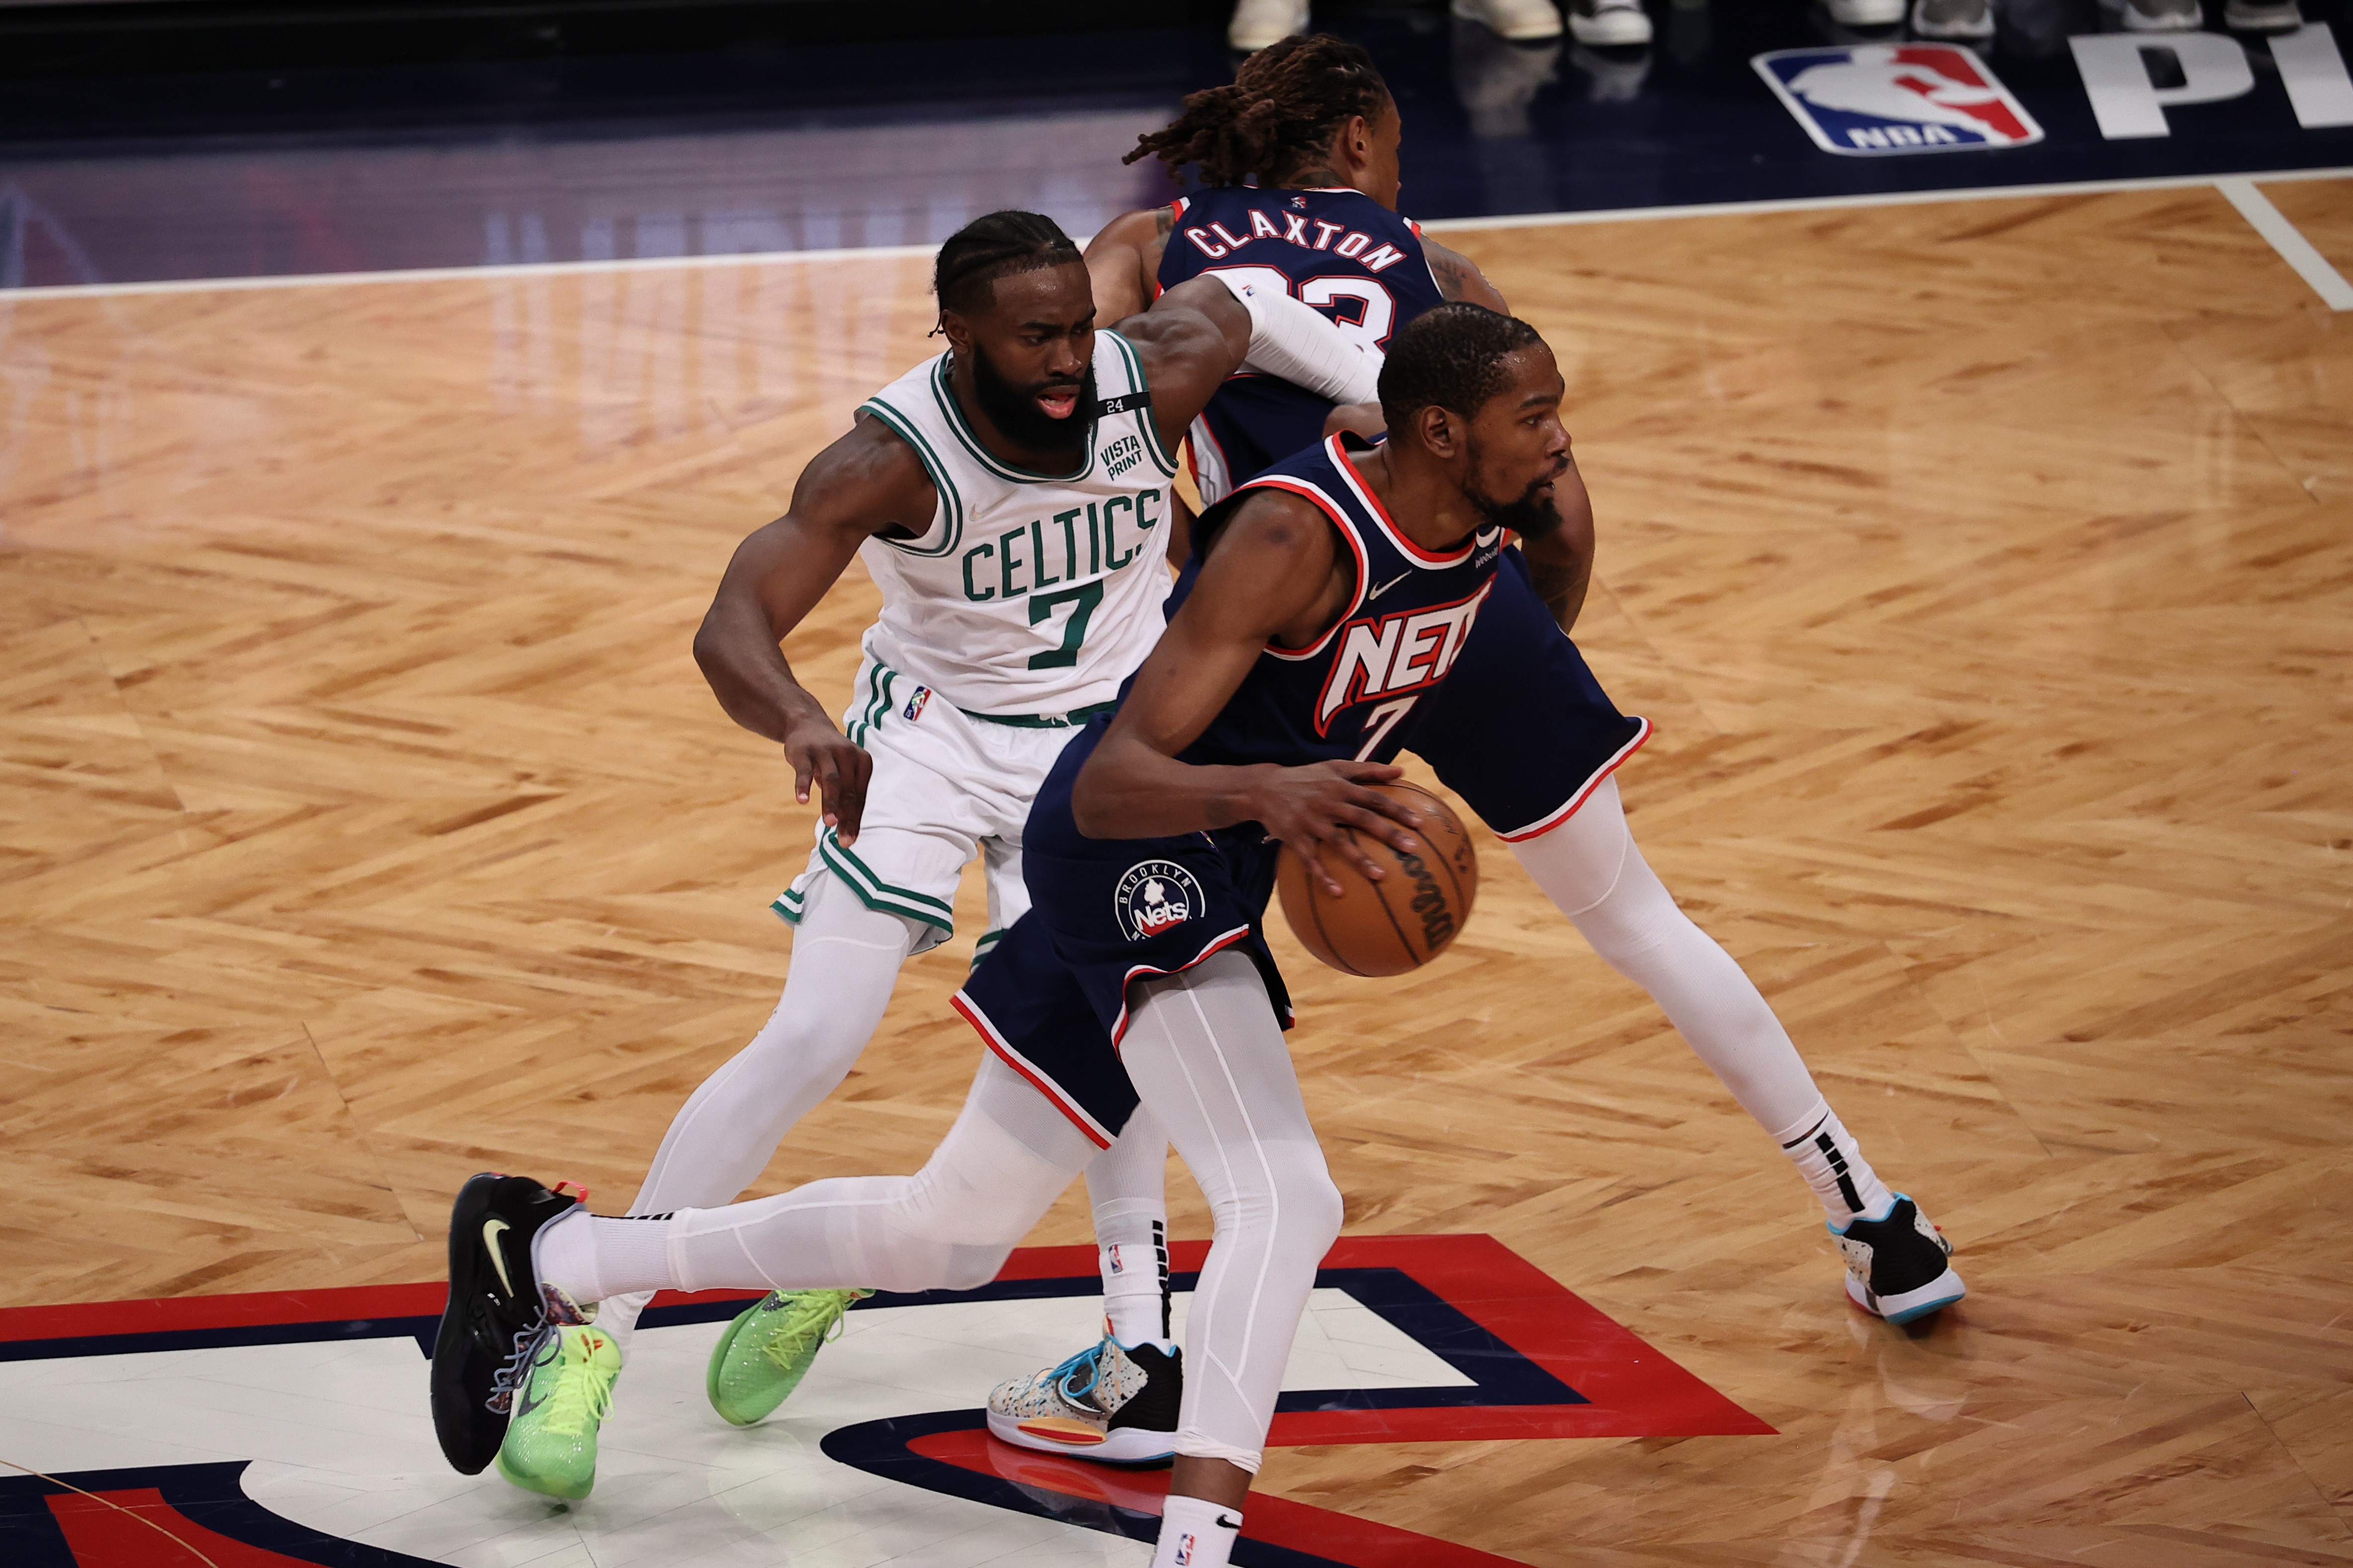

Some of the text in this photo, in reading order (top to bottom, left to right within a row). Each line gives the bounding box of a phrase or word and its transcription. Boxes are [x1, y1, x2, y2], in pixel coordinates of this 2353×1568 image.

[1846, 125, 1958, 148] NBA
[1184, 209, 1407, 273] CLAXTON
[1106, 399, 1124, 414] 24
[1100, 435, 1141, 467] VISTA
[1107, 449, 1142, 482] PRINT
[1028, 580, 1103, 671] 7
[1361, 693, 1423, 762] 7
[1118, 864, 1192, 904] BROOKLYN
[1133, 901, 1187, 931] Nets
